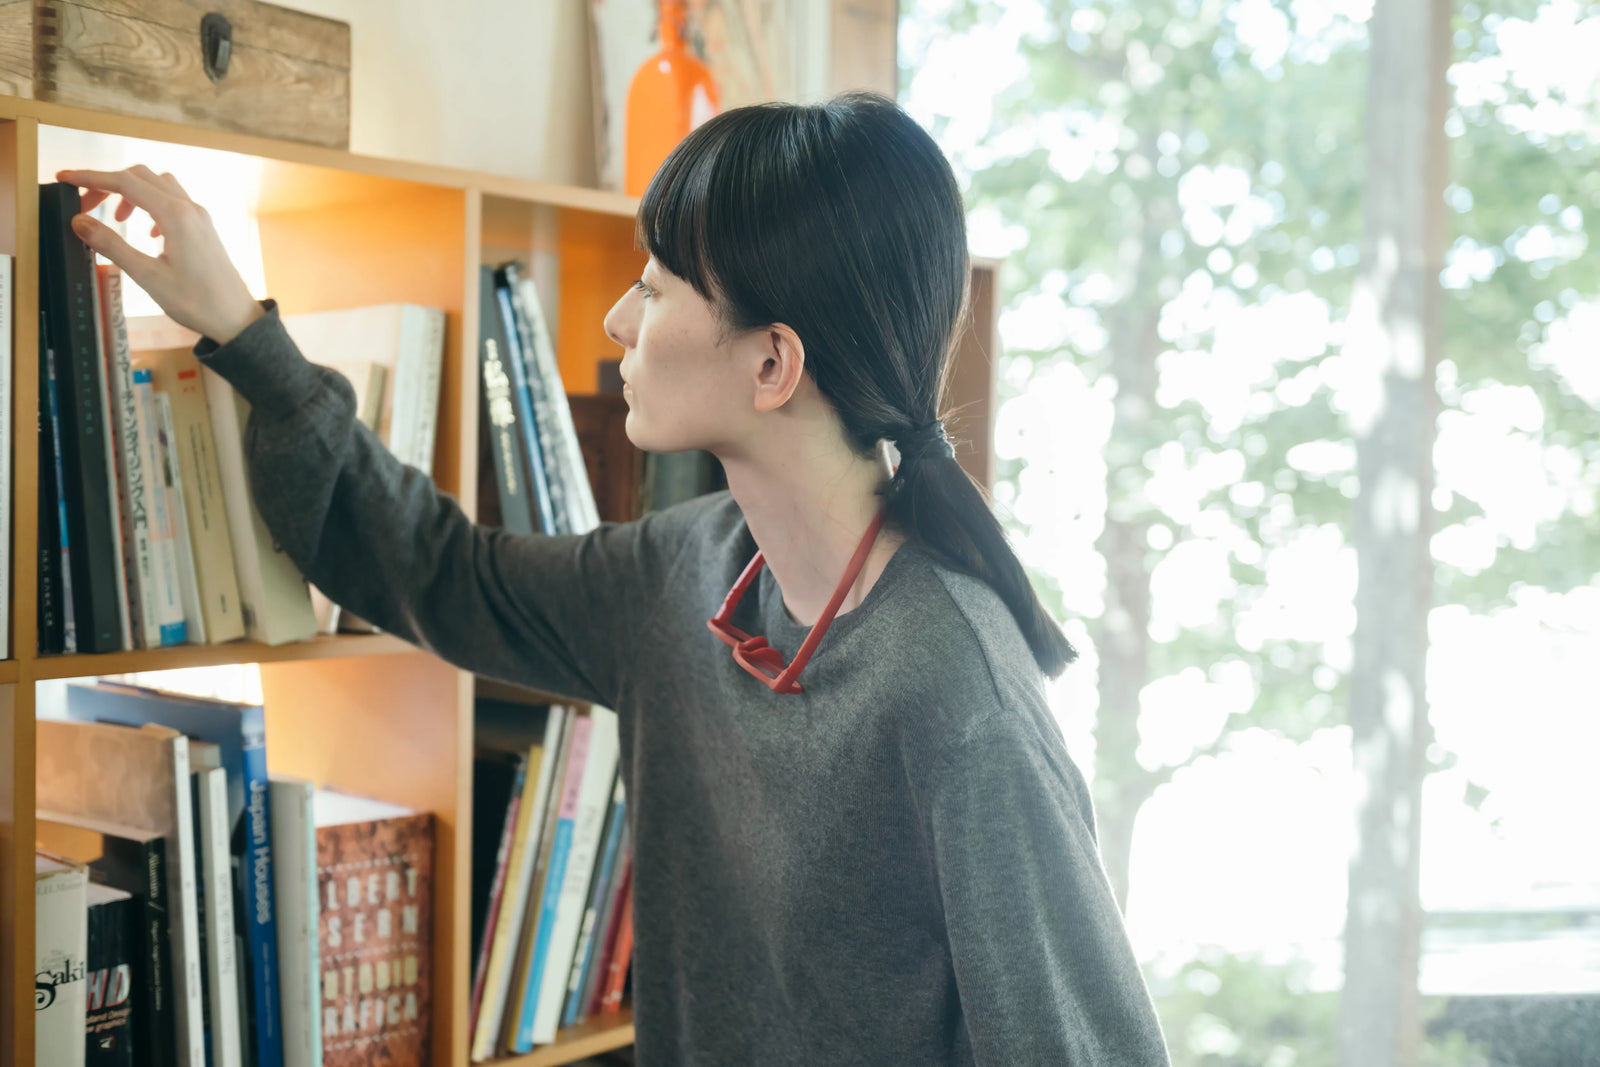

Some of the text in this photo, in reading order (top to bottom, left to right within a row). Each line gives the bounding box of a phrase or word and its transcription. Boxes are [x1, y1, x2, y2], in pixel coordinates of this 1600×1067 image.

[76, 283, 94, 435] HANS HARTUNG
[249, 780, 268, 844] Japan
[254, 847, 271, 924] Houses
[328, 868, 418, 909] LBERT
[328, 906, 418, 947] SERN
[35, 959, 85, 1011] Saki
[86, 963, 132, 1011] HD
[324, 955, 418, 1000] UTOBIO
[324, 991, 418, 1036] RÀFICA
